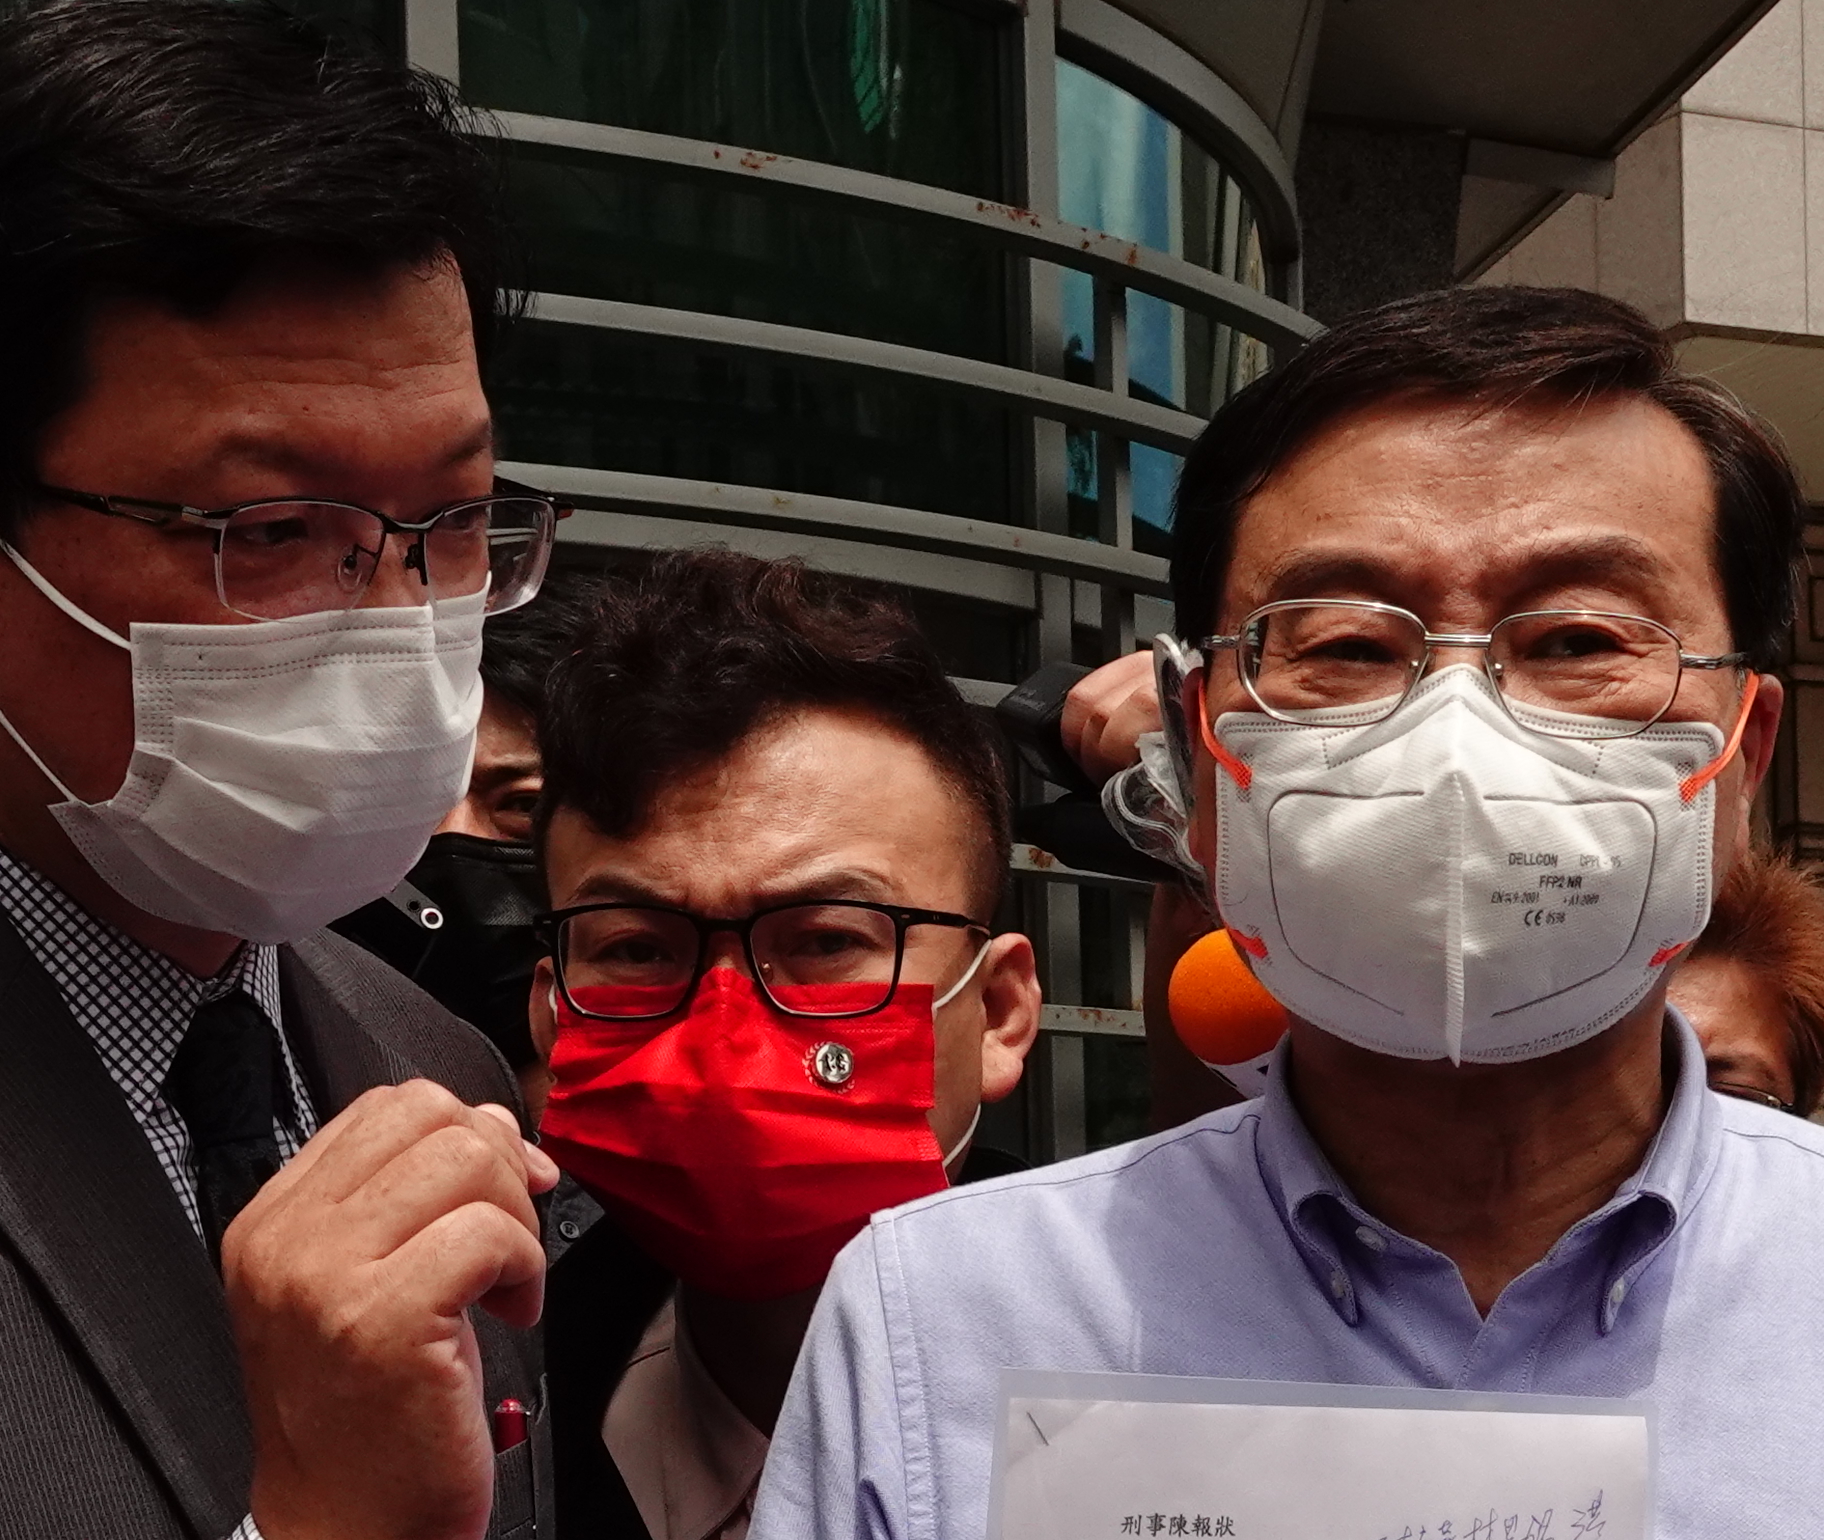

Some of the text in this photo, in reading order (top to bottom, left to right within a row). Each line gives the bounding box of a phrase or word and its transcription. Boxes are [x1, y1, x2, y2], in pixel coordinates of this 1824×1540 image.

[1120, 1512, 1236, 1538] 刑事陳報狀
